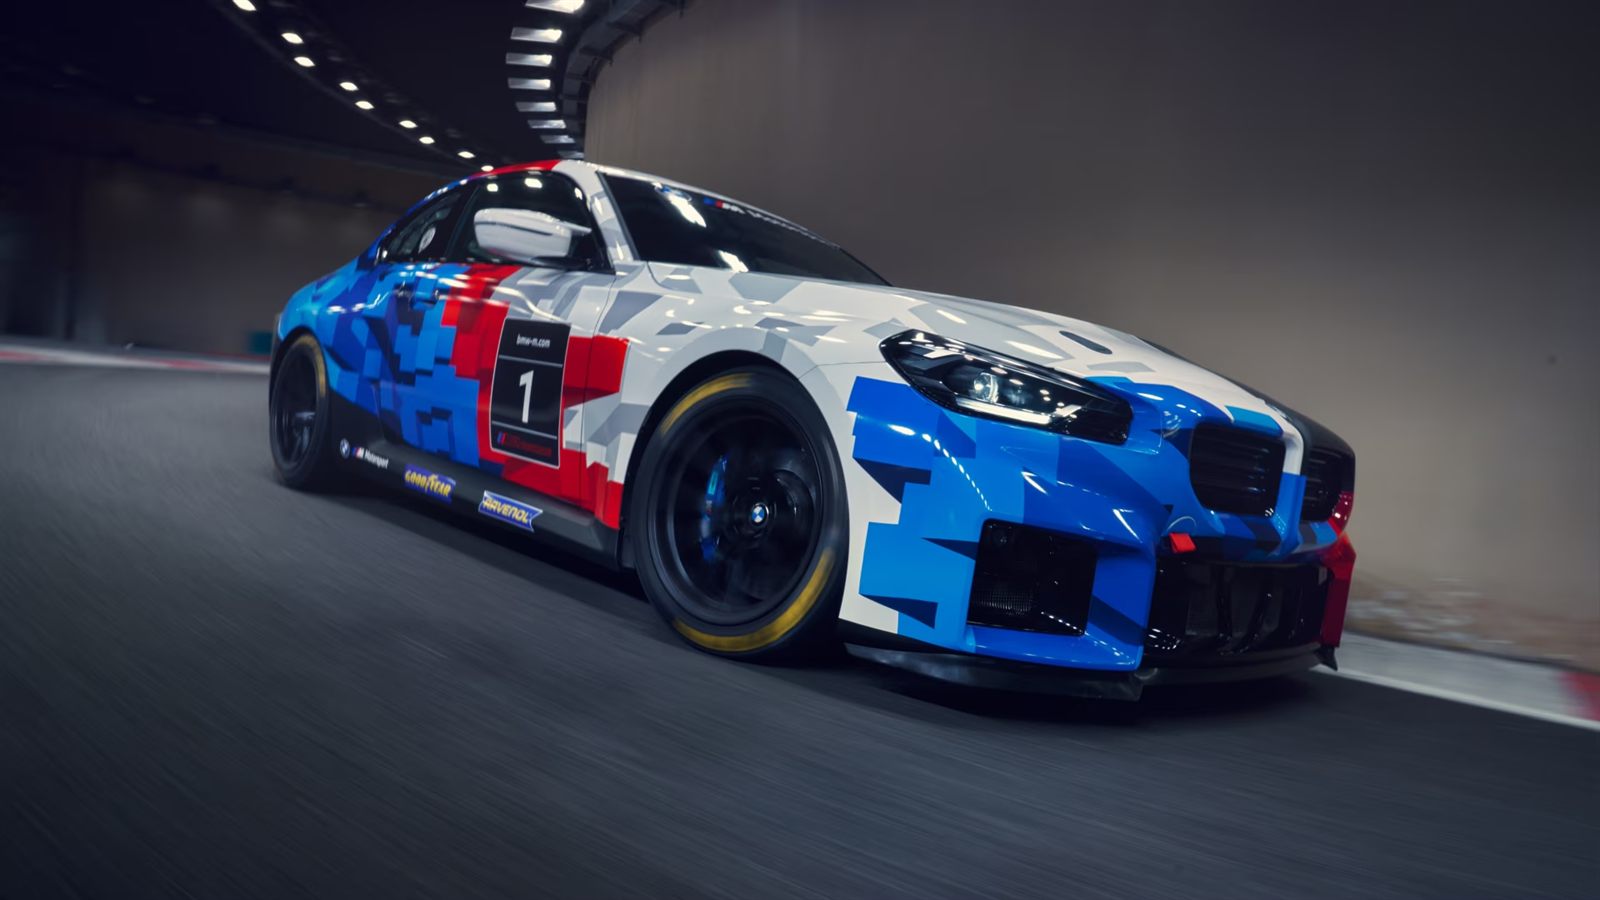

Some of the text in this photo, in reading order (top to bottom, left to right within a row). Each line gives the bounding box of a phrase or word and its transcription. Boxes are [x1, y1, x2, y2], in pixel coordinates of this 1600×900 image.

[516, 333, 551, 349] bmw-m.com
[519, 369, 535, 424] 1
[405, 469, 451, 497] GOODYEAR
[482, 497, 529, 524] RAVENOL
